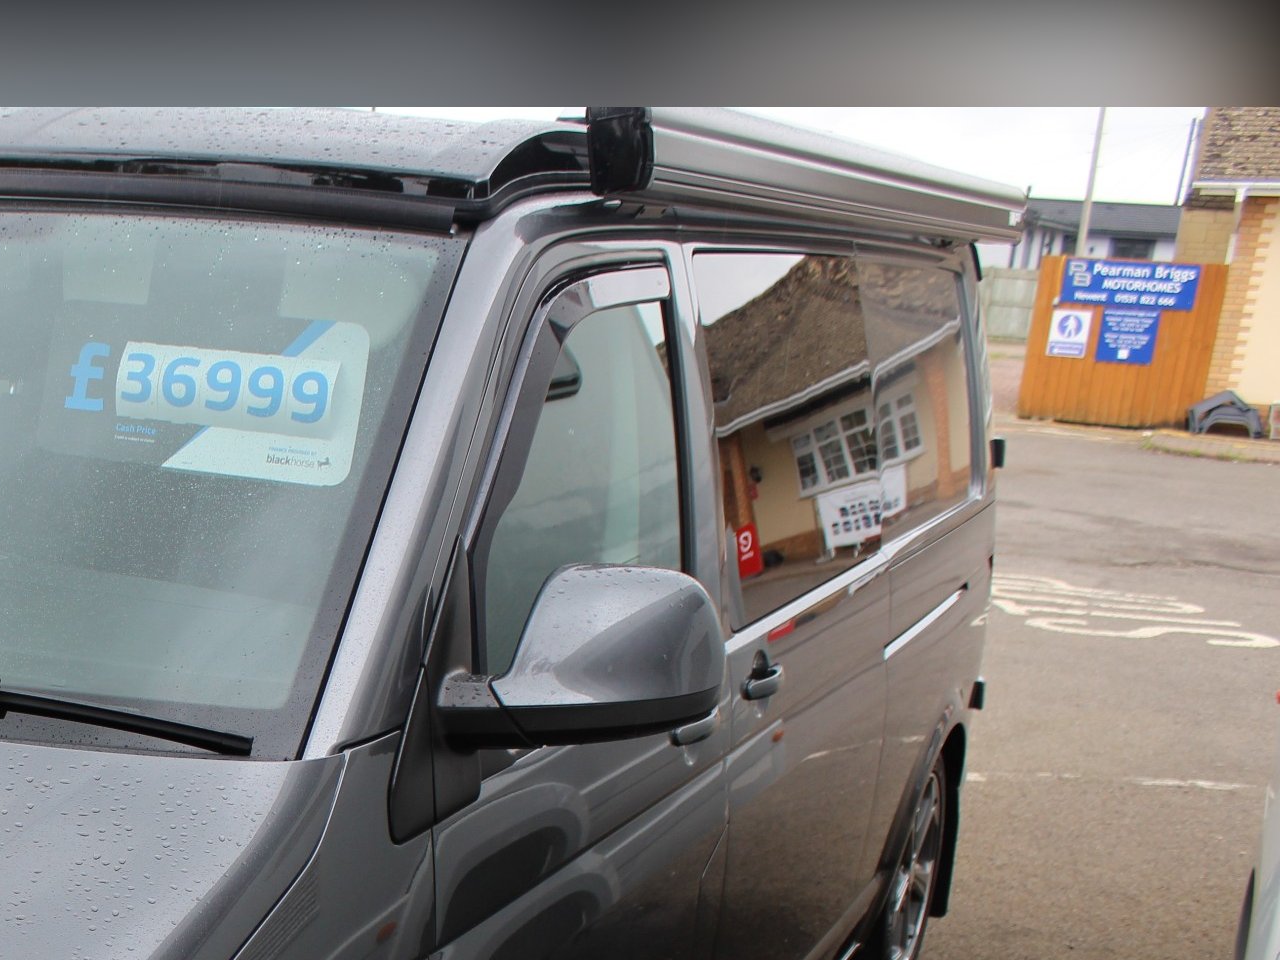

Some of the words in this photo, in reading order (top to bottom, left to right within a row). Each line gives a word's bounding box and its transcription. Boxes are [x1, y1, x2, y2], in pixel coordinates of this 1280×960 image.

[1093, 263, 1151, 278] Pearman
[1155, 266, 1197, 283] Briggs
[1102, 279, 1183, 294] MOTORHOMES
[115, 423, 135, 433] Cash
[136, 425, 157, 437] Price
[266, 453, 315, 469] blackhorse
